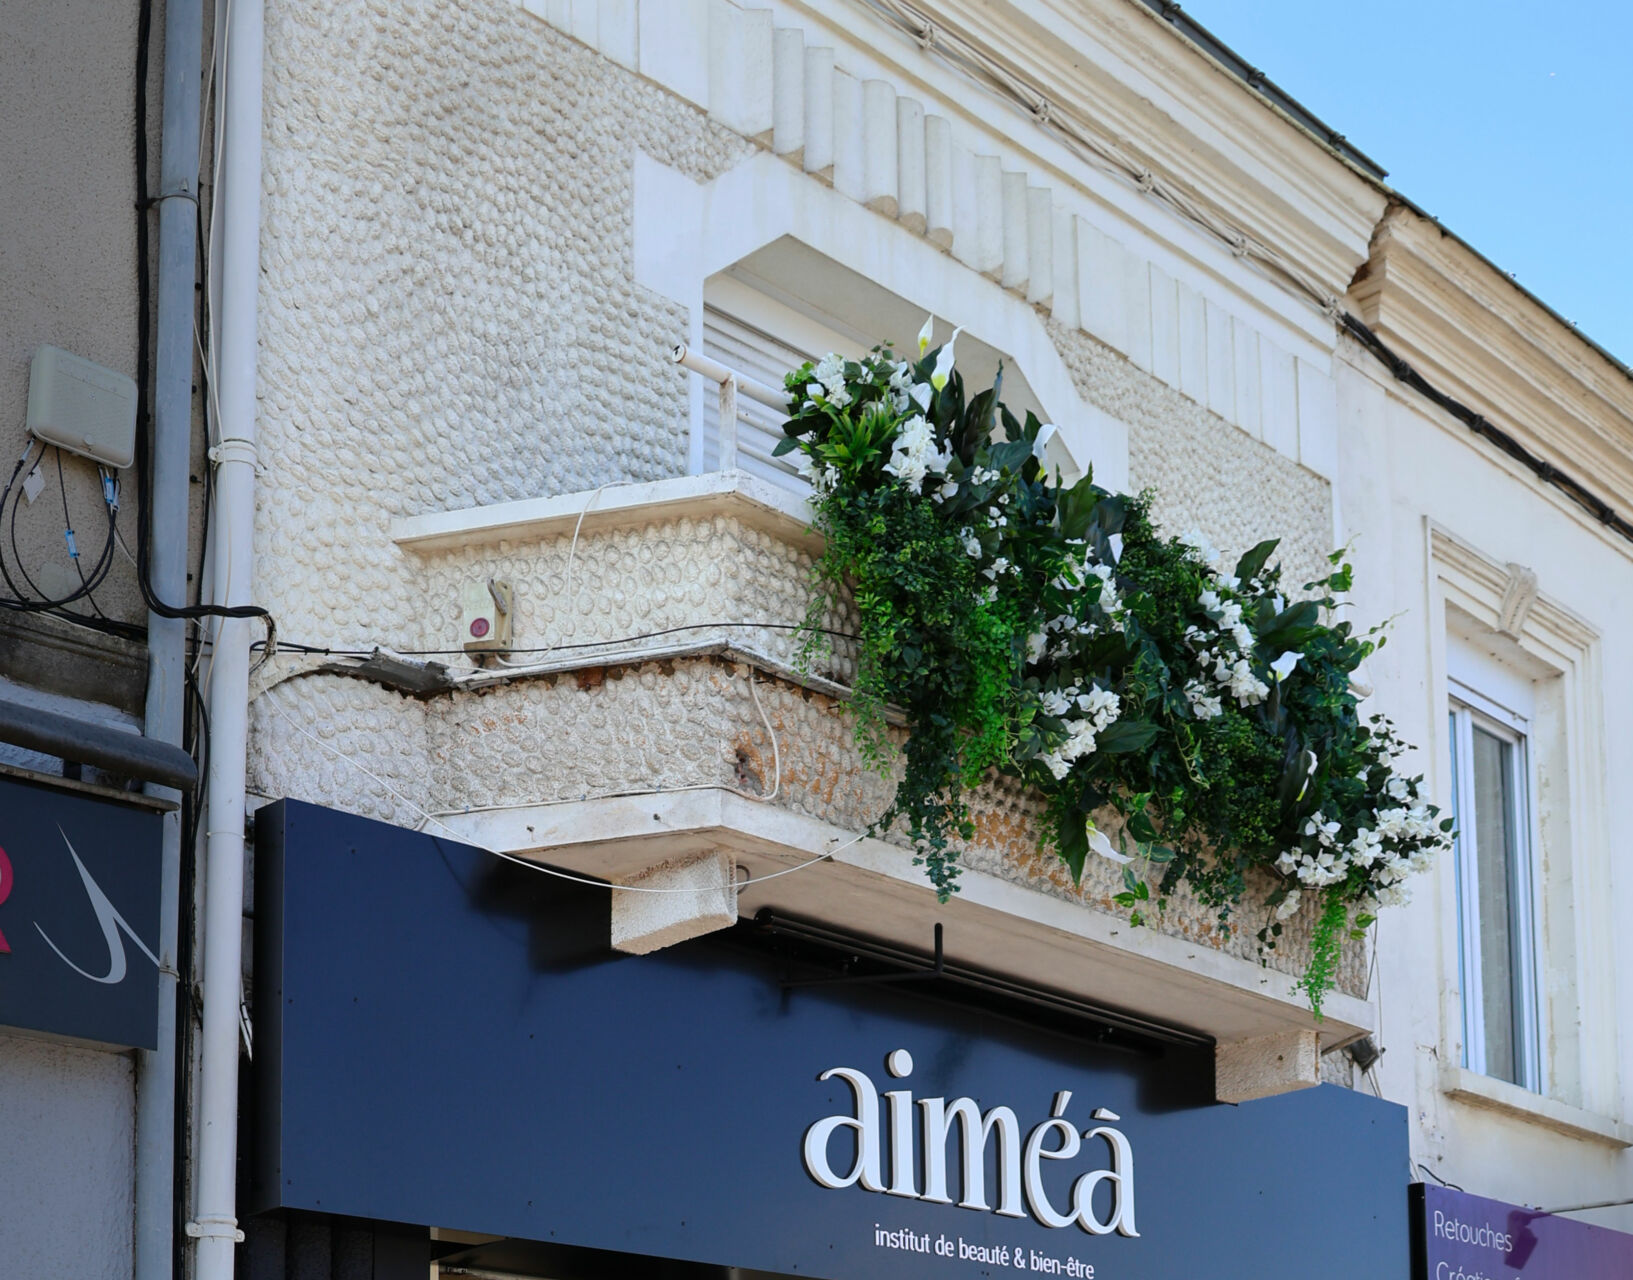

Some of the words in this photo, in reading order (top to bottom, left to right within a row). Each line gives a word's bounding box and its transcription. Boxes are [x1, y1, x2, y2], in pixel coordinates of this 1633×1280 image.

[874, 1223, 931, 1254] institut
[934, 1234, 955, 1257] de
[958, 1237, 1010, 1266] beauté
[1013, 1247, 1026, 1269] &
[1030, 1249, 1095, 1280] bien-être
[1434, 1210, 1513, 1252] Retouches
